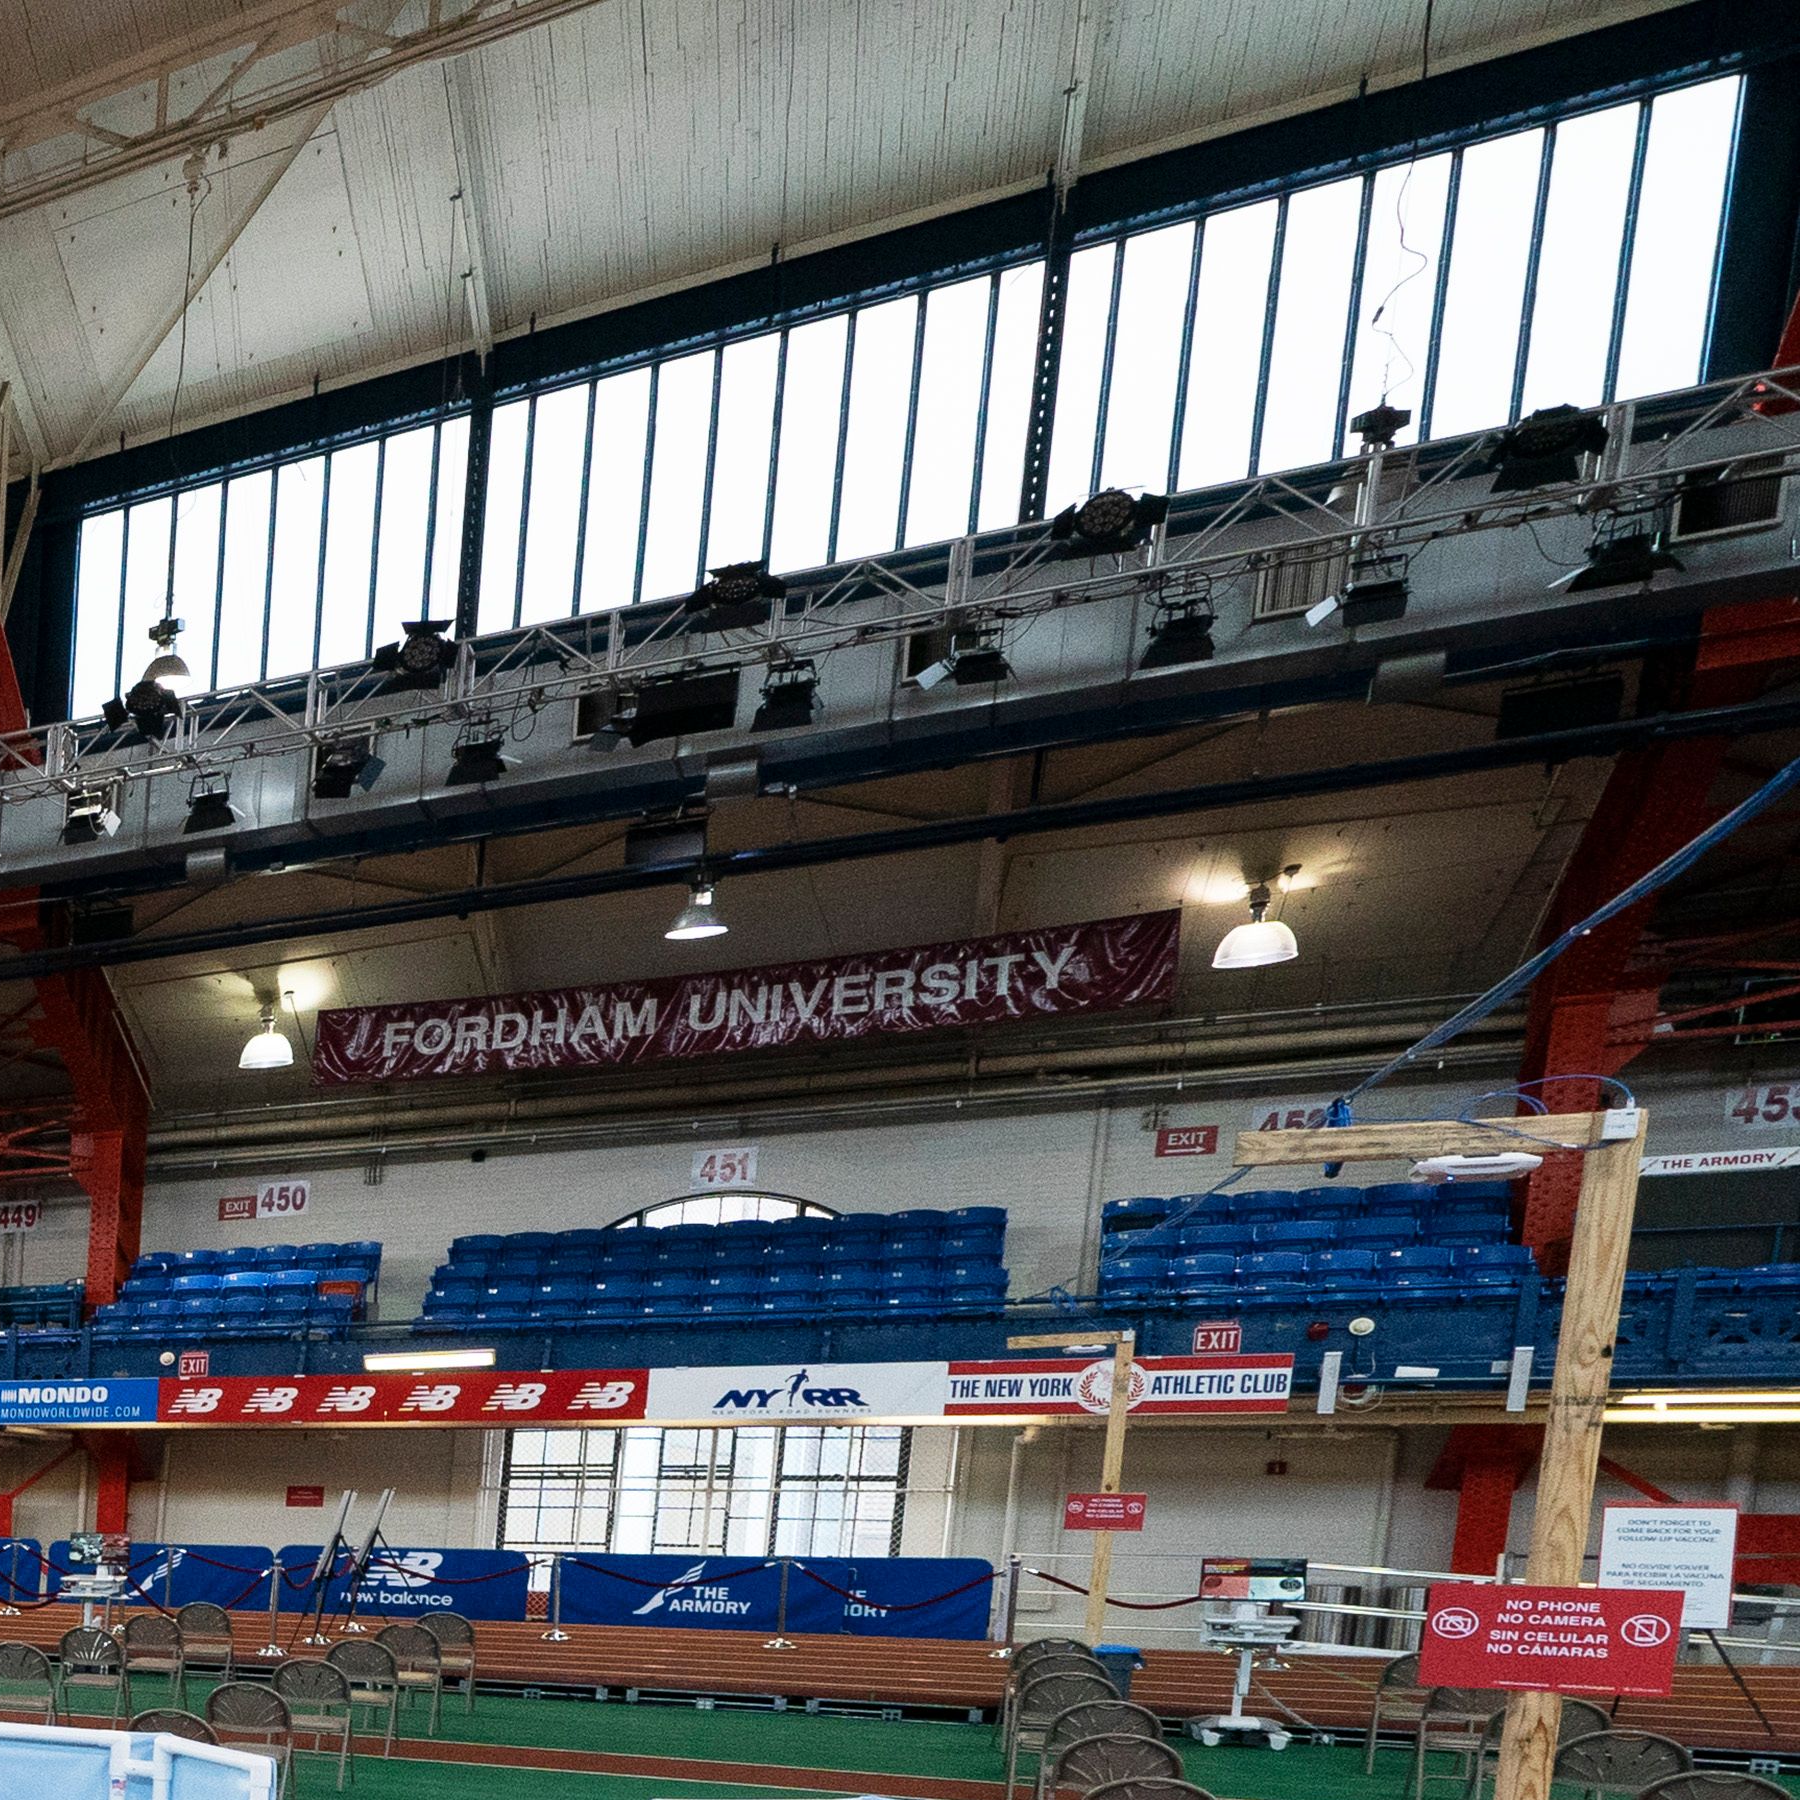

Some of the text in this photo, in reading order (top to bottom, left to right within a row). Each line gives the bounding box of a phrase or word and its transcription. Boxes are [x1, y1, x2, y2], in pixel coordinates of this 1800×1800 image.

[383, 945, 1079, 1057] FORDHAM UNIVERSITY
[1166, 1130, 1208, 1146] EXIT
[699, 1152, 750, 1184] 451
[1662, 1152, 1777, 1170] THE ARMORY
[225, 1200, 251, 1213] EXIT
[261, 1185, 306, 1213] 450
[1196, 1330, 1239, 1351] EXIT
[180, 1358, 206, 1374] EXIT
[951, 1373, 1288, 1398] THE NEW YORK ATHLETIC CLUB
[17, 1386, 108, 1404] MONDO
[692, 1586, 729, 1600] THE
[668, 1599, 752, 1616] ARMORY
[1505, 1600, 1601, 1613] NO PHONE
[1496, 1612, 1607, 1628] NO CAMERA
[1489, 1629, 1610, 1645] SIN CELULAR
[1485, 1643, 1610, 1659] NO CÁMARAS
